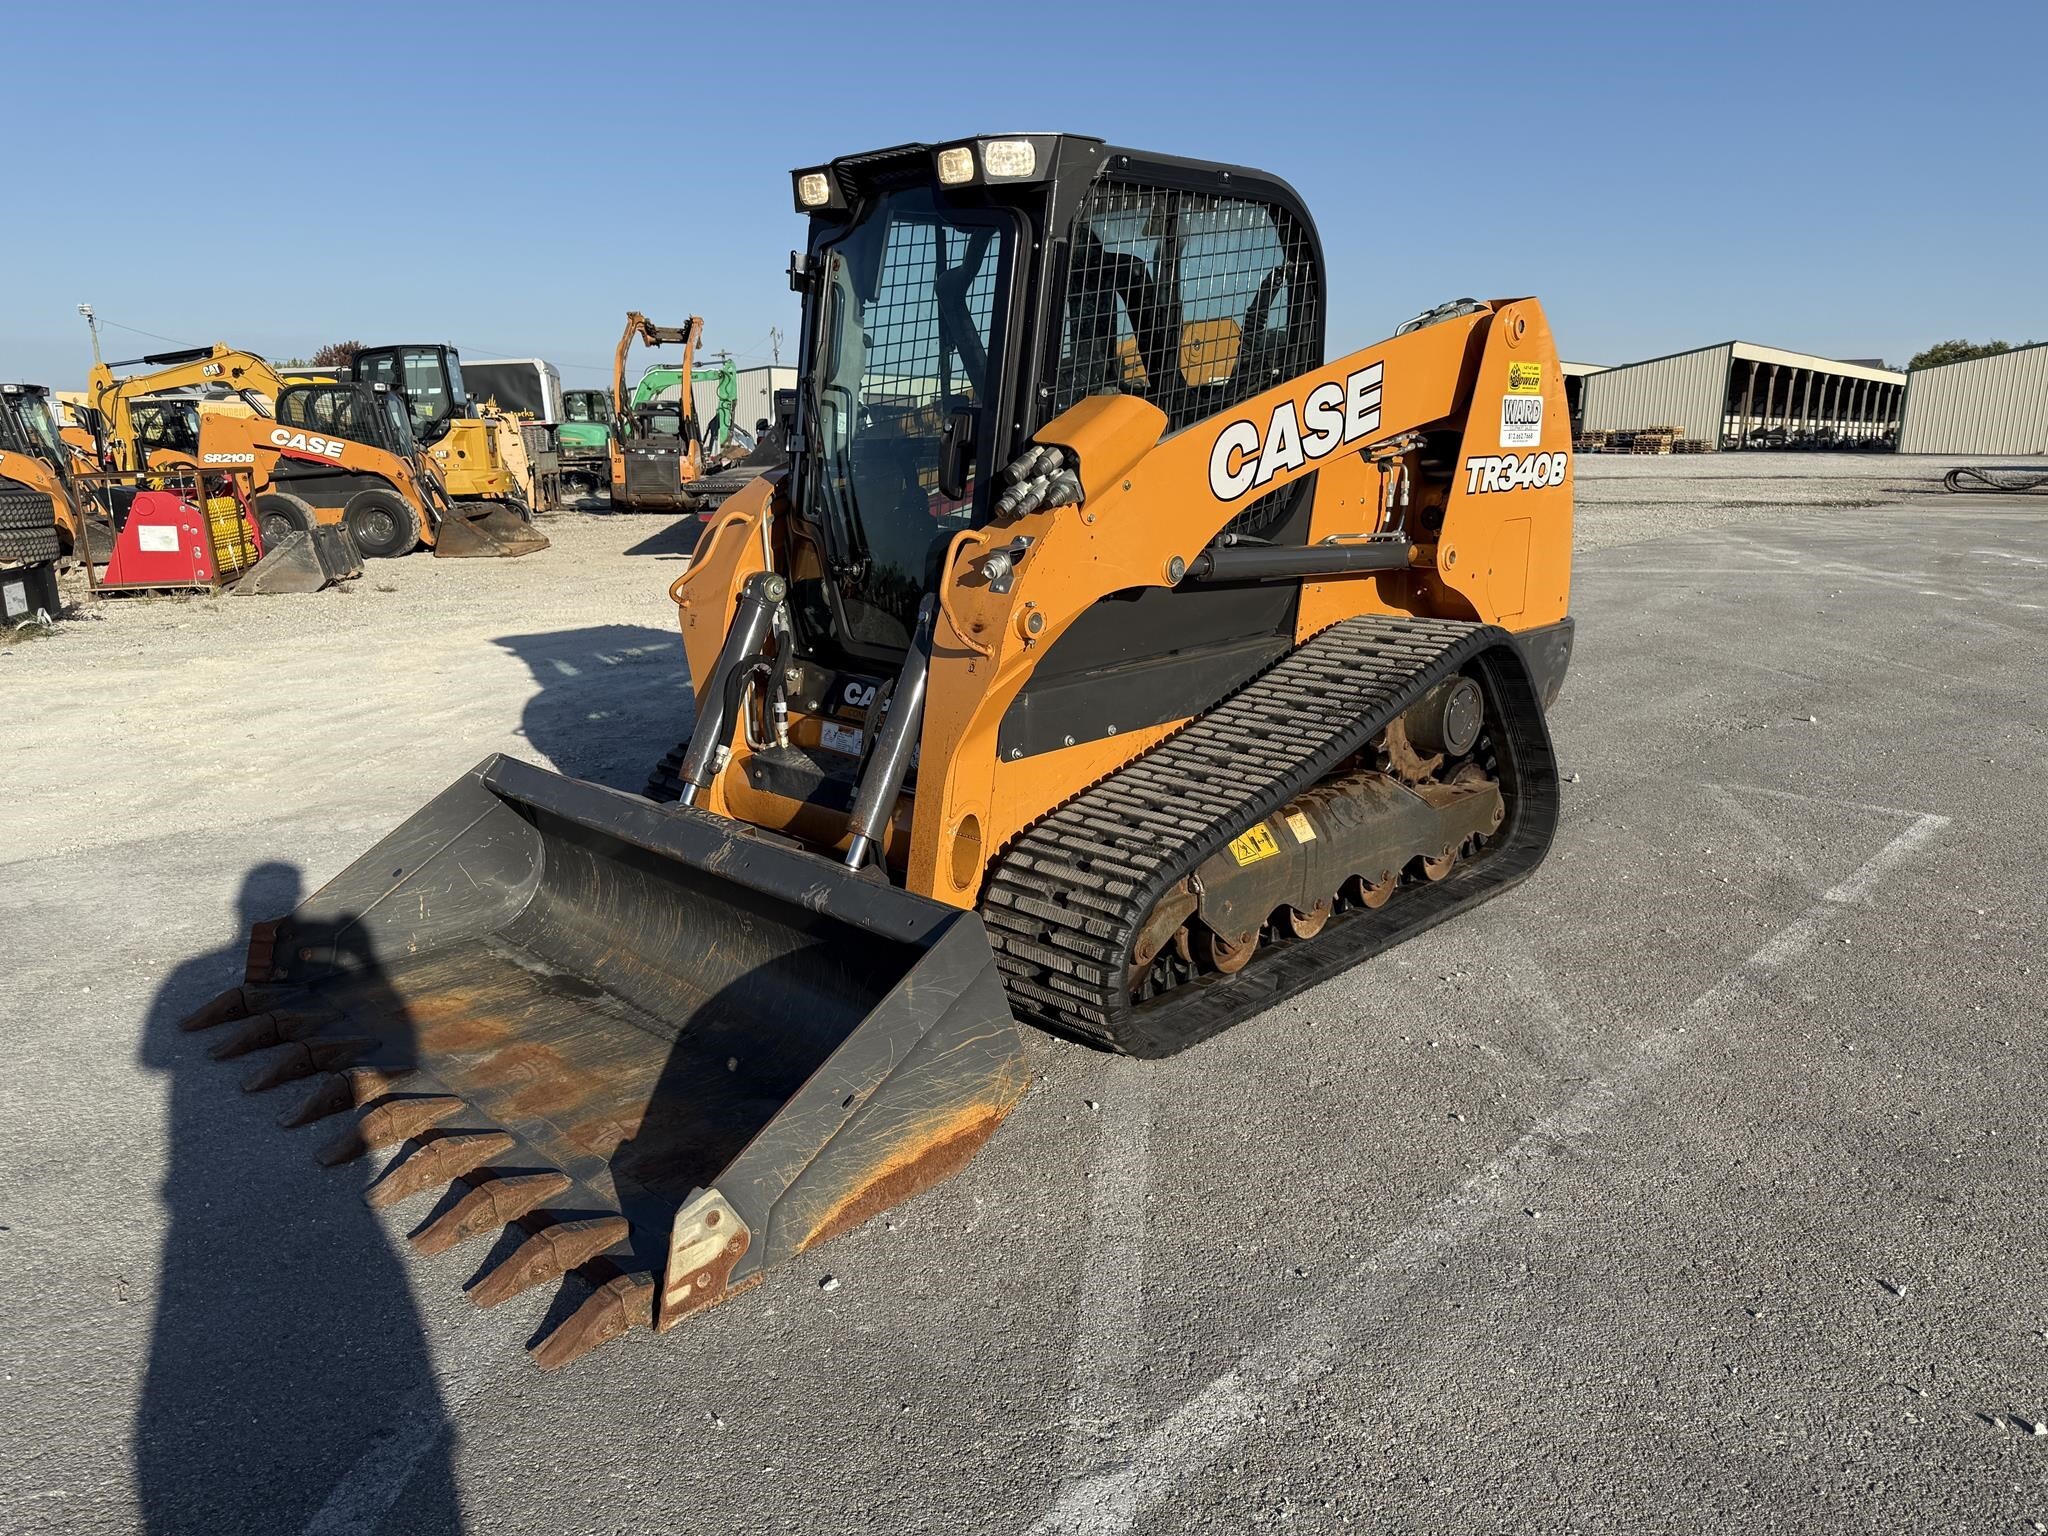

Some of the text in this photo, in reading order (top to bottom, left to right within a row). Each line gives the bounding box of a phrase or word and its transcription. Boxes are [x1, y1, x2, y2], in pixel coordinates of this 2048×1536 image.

[203, 363, 220, 376] CAT
[1504, 399, 1541, 424] WARD
[270, 429, 345, 458] CASE
[1208, 360, 1384, 502] CASE
[203, 453, 255, 463] SR210B
[1466, 452, 1568, 495] TR340B
